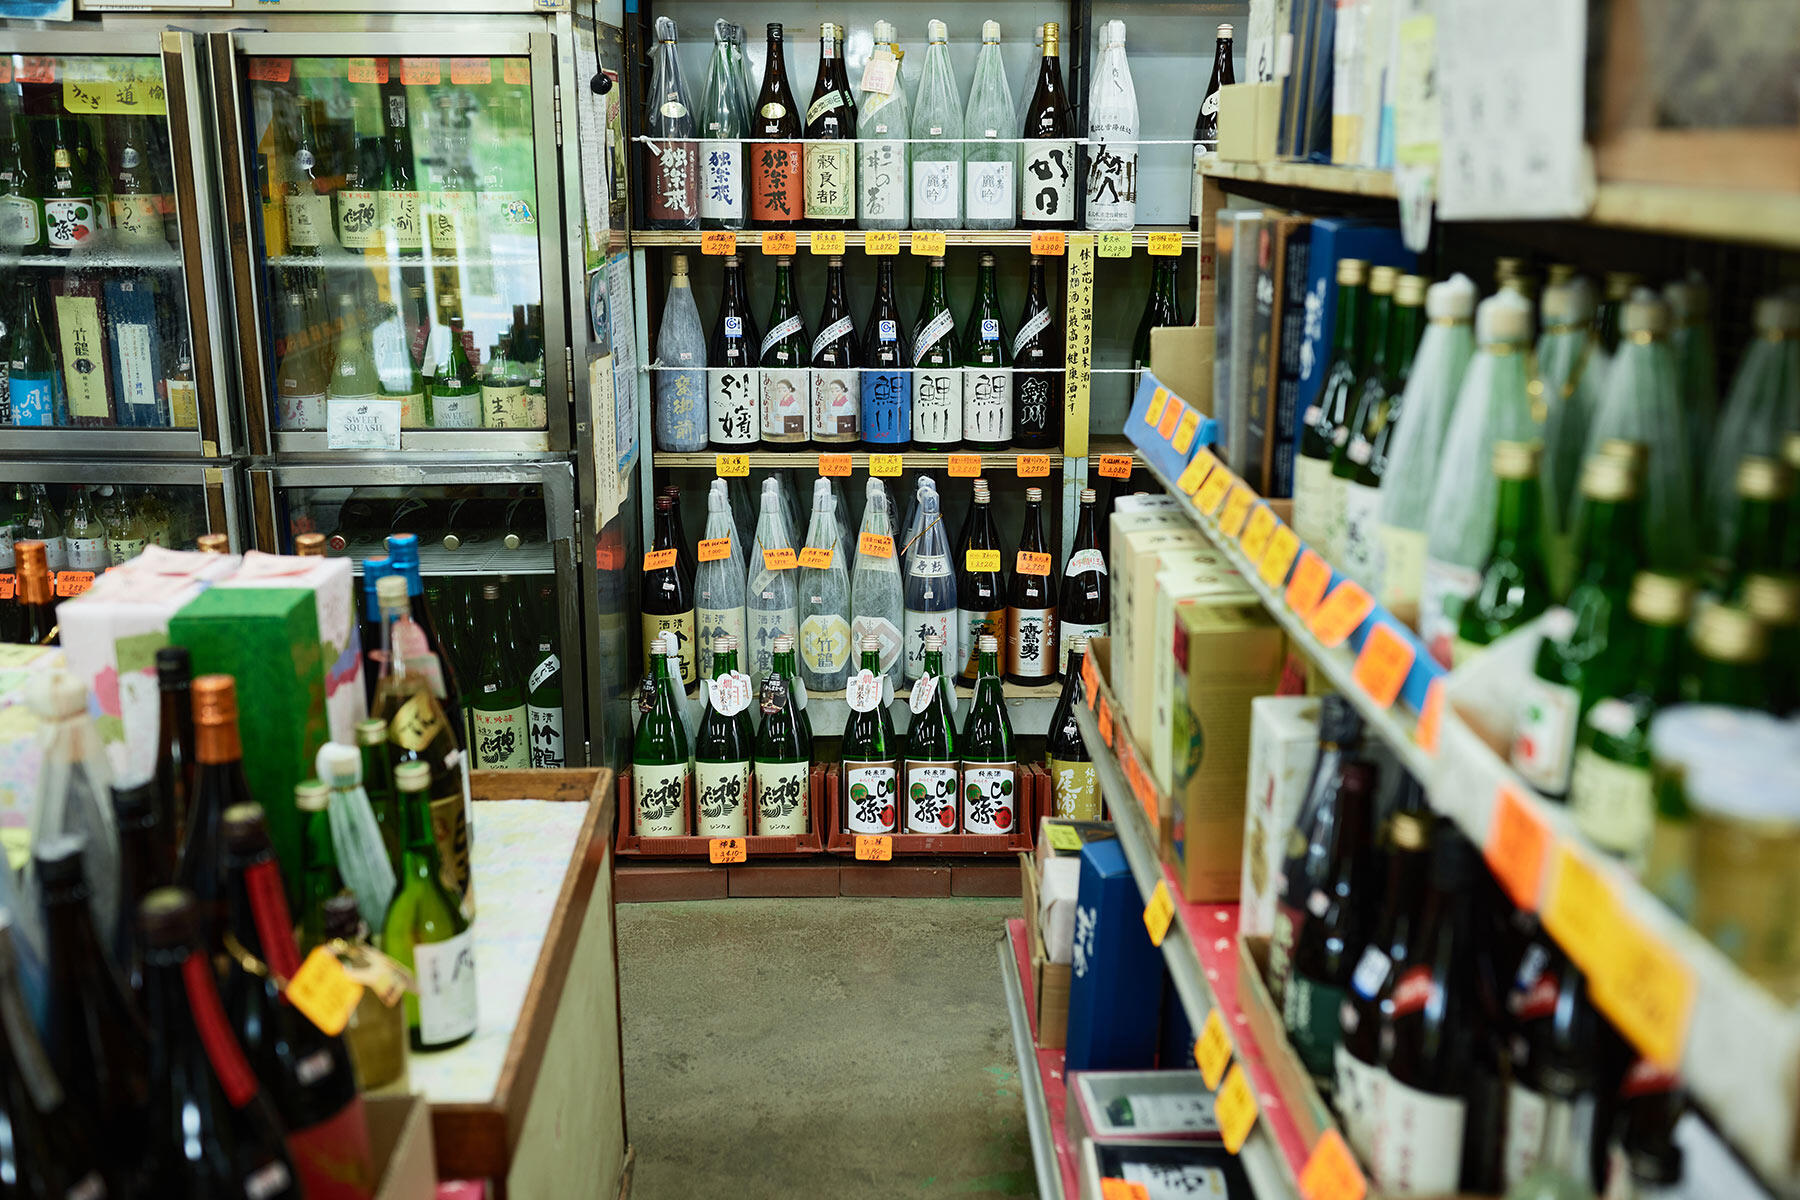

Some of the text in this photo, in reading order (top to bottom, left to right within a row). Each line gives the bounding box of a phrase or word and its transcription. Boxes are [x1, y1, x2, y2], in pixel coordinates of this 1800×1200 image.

[116, 85, 138, 106] 道
[72, 328, 89, 357] 竹鶴
[346, 415, 380, 424] SWEET
[344, 423, 384, 432] SQUASH
[659, 618, 684, 630] 清酒
[702, 614, 725, 625] 清酒
[1019, 623, 1044, 661] 鷹勇
[816, 637, 834, 668] 竹鶴
[531, 710, 554, 724] 清酒
[531, 723, 564, 769] 竹鶴
[864, 769, 887, 777] 純米酒
[651, 823, 673, 832] シンカメ
[709, 822, 732, 831] シンカメ
